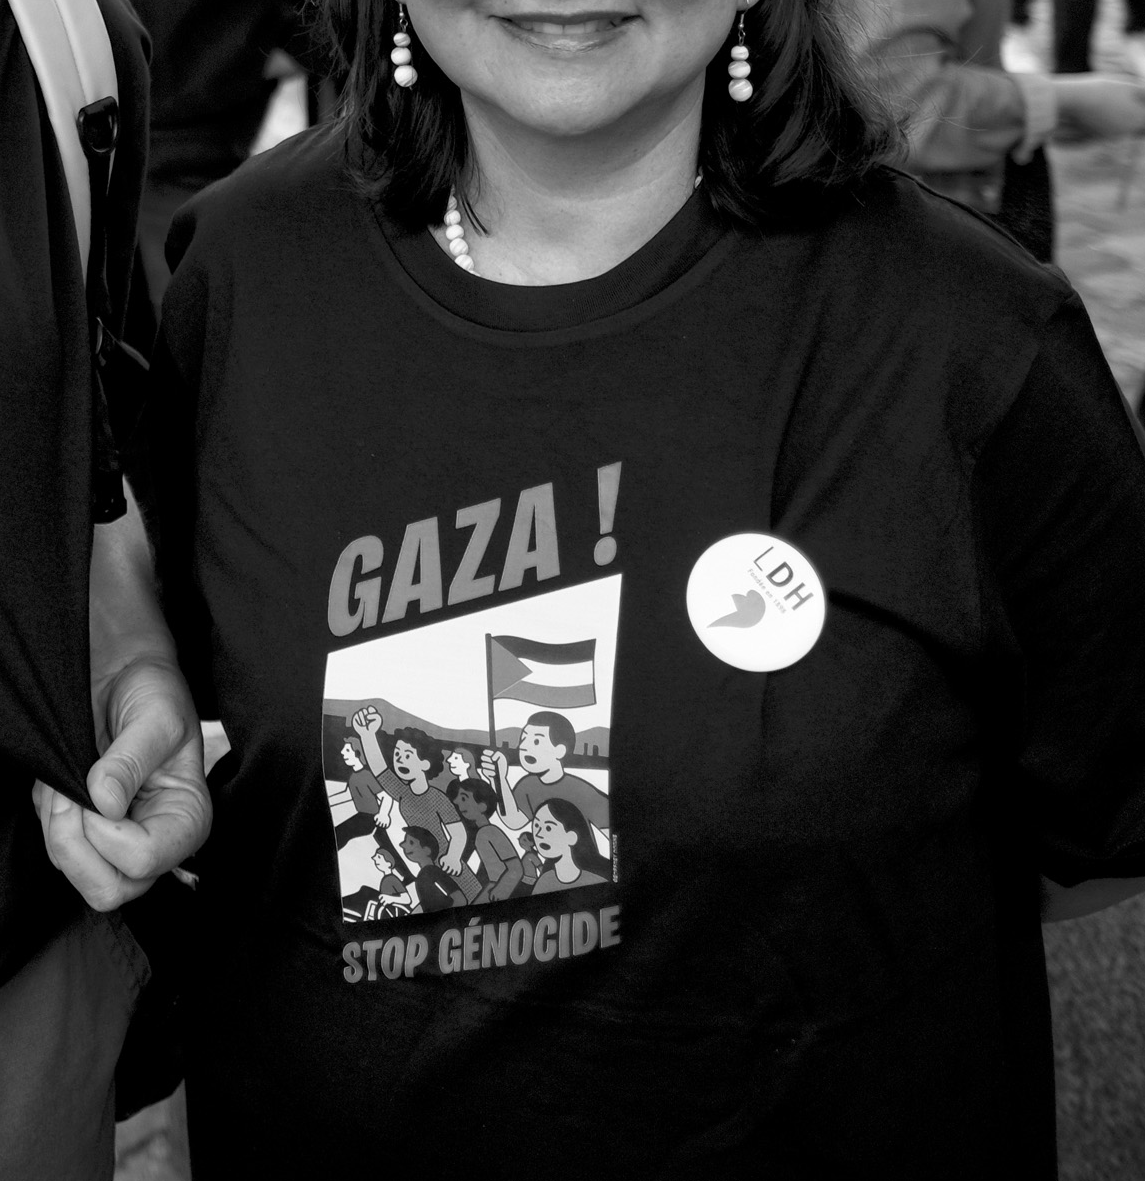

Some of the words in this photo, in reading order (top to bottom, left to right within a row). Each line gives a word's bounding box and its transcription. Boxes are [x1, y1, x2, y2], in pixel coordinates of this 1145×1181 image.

[327, 482, 561, 637] GAZA
[593, 461, 622, 566] !
[753, 545, 814, 611] LDH
[342, 933, 429, 984] STOP
[438, 905, 621, 974] GÉNOCIDE
